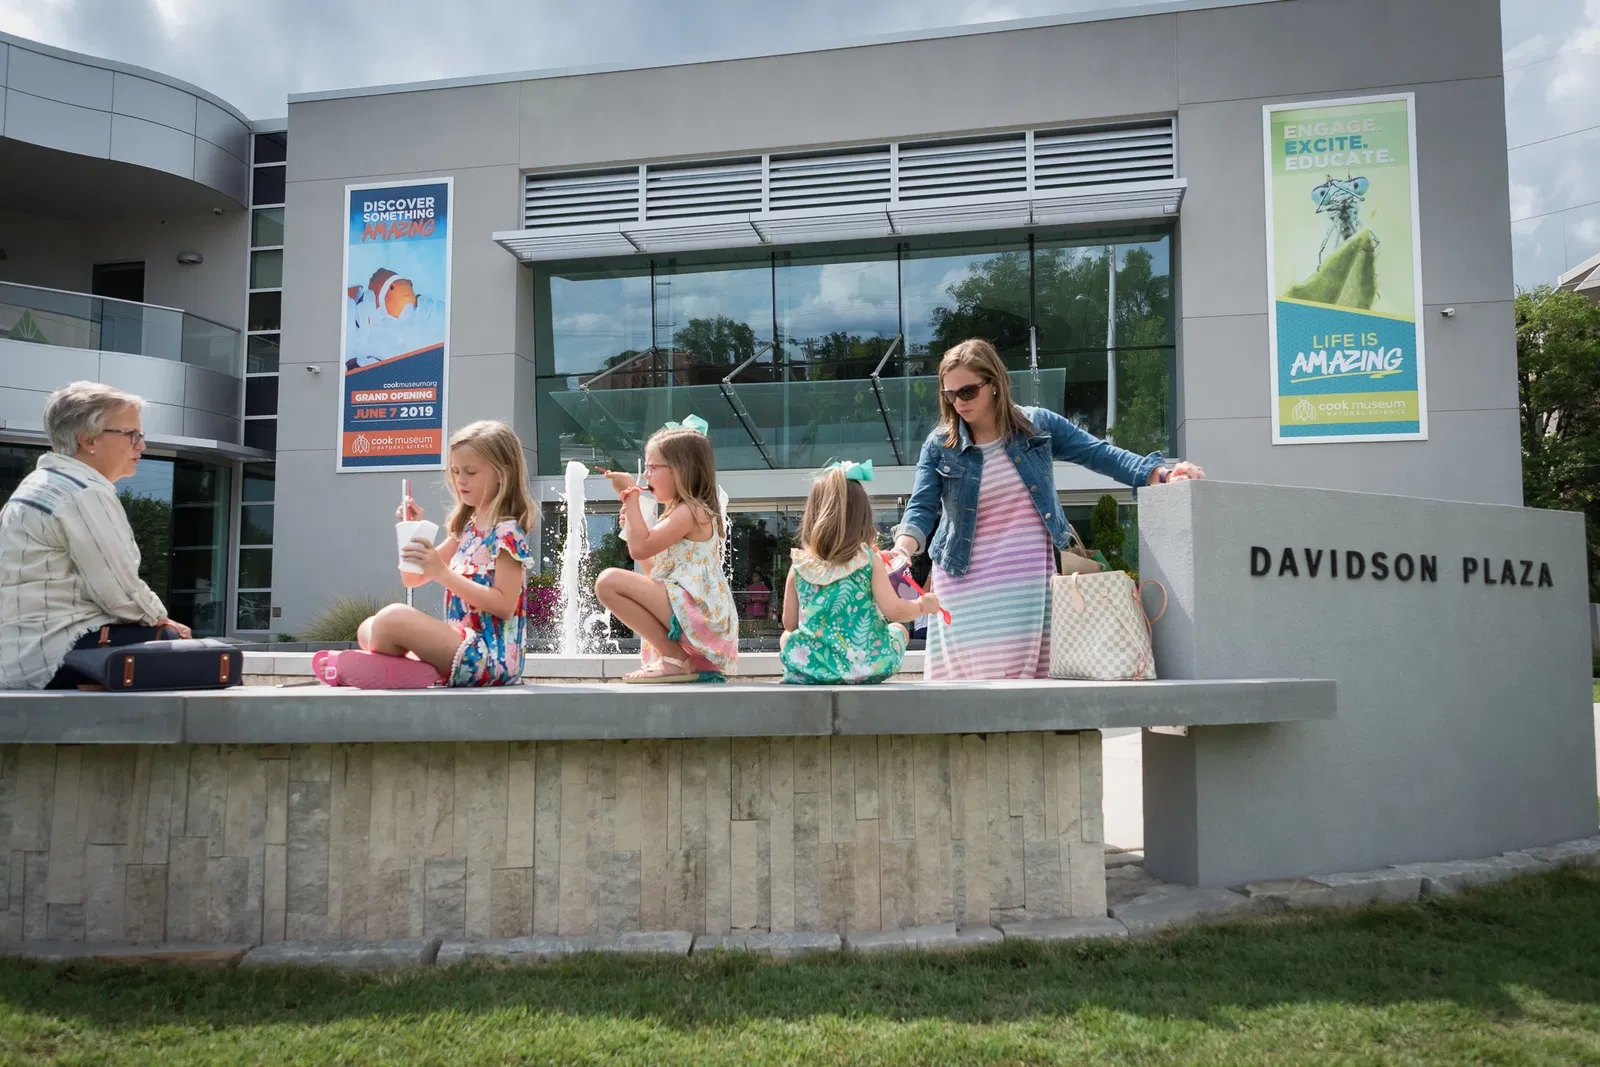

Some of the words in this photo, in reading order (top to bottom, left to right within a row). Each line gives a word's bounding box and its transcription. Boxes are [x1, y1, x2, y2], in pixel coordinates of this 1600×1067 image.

[1284, 118, 1383, 139] ENGAGE.
[1285, 135, 1369, 155] EXCITE.
[1285, 149, 1396, 171] EDUCATE.
[364, 196, 434, 212] DISCOVER
[364, 208, 434, 222] SOMETHING
[361, 218, 434, 242] AMAZING
[1313, 333, 1355, 348] LIFE
[1361, 332, 1378, 346] IS
[1290, 346, 1404, 376] AMAZING
[355, 393, 388, 402] GRAND
[390, 391, 433, 400] OPENING
[354, 408, 386, 419] JUNE
[389, 408, 397, 418] 7
[400, 406, 433, 417] 2019
[1318, 400, 1349, 411] cook
[1352, 400, 1405, 409] museum
[372, 436, 393, 445] cook
[1250, 546, 1437, 582] DAVIDSON
[1463, 557, 1553, 588] PLAZA
